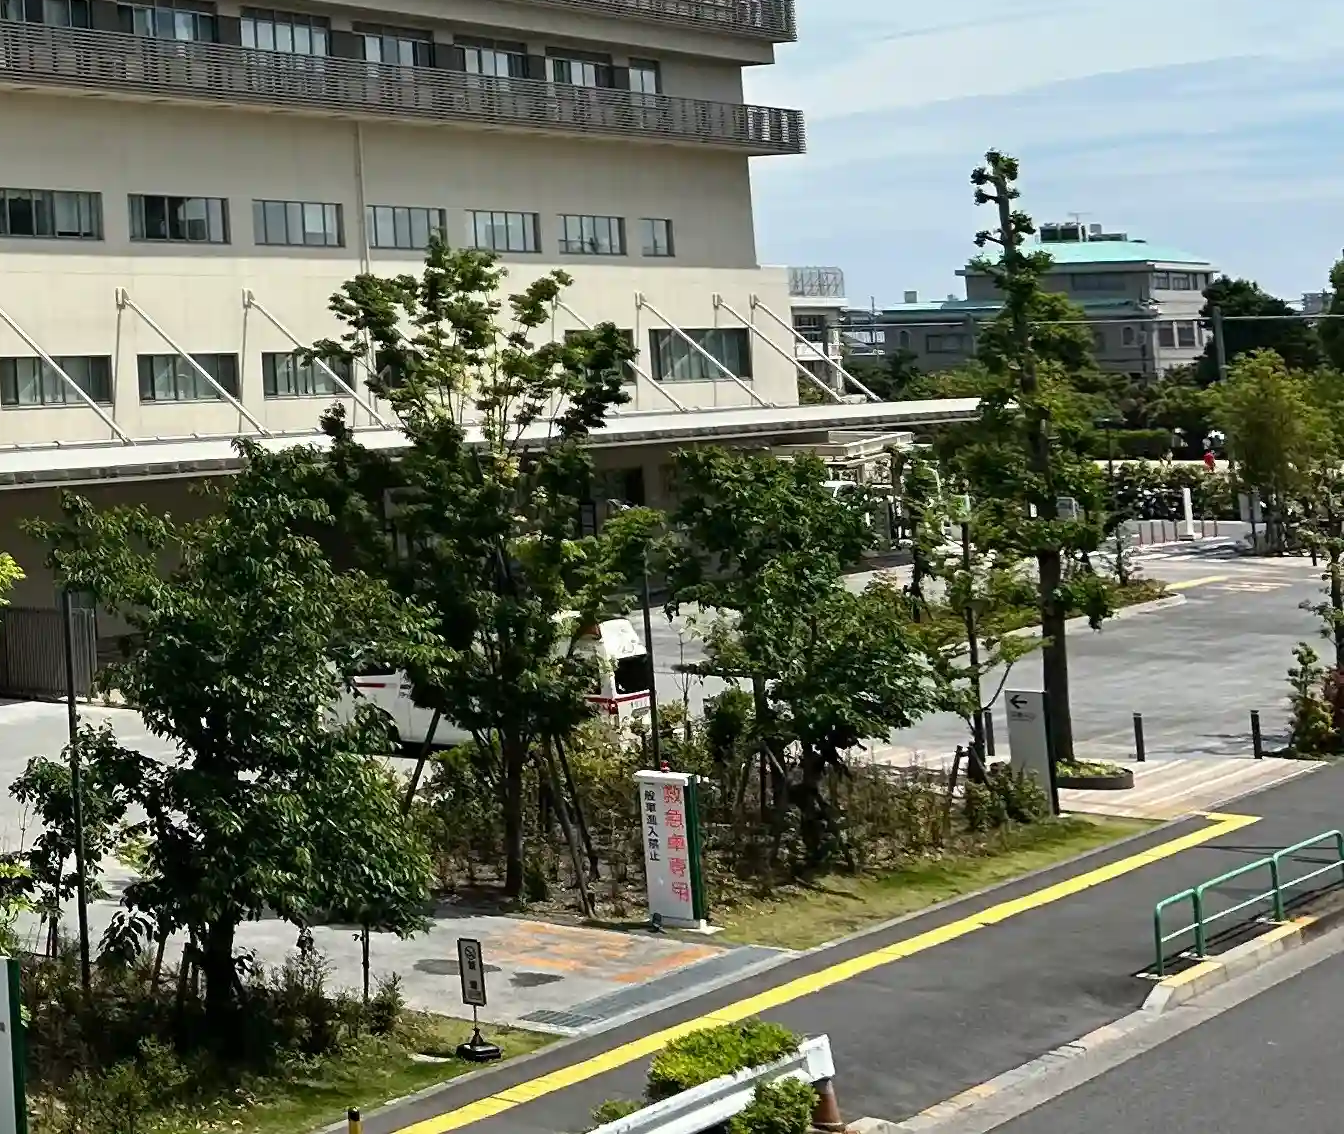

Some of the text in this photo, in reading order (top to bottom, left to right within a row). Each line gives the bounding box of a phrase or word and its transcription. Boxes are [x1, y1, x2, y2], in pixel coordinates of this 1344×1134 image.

[644, 782, 660, 861] 一般車進入禁止
[663, 785, 689, 902] 救急車専用
